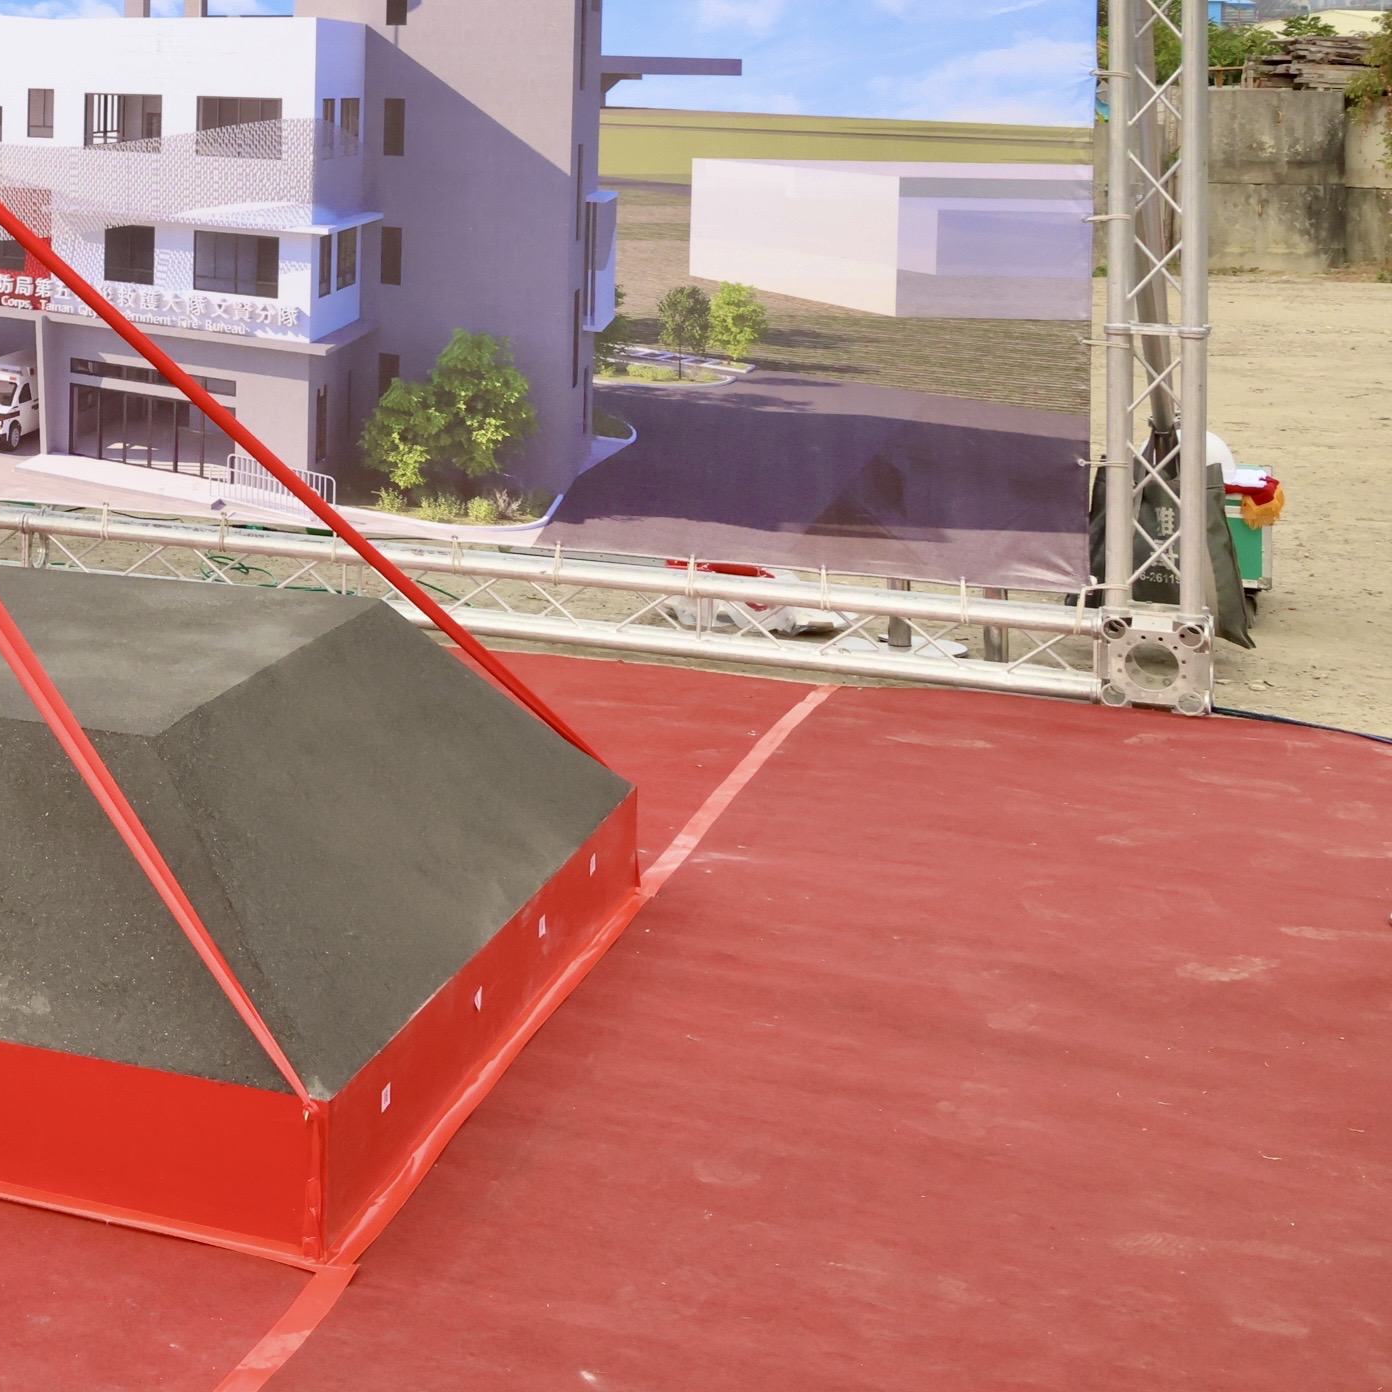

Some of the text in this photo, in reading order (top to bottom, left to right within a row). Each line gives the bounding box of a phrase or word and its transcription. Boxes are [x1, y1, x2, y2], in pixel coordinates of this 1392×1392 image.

[1, 295, 33, 310] Corps,
[40, 299, 74, 314] Tainan
[205, 319, 247, 335] Bureau
